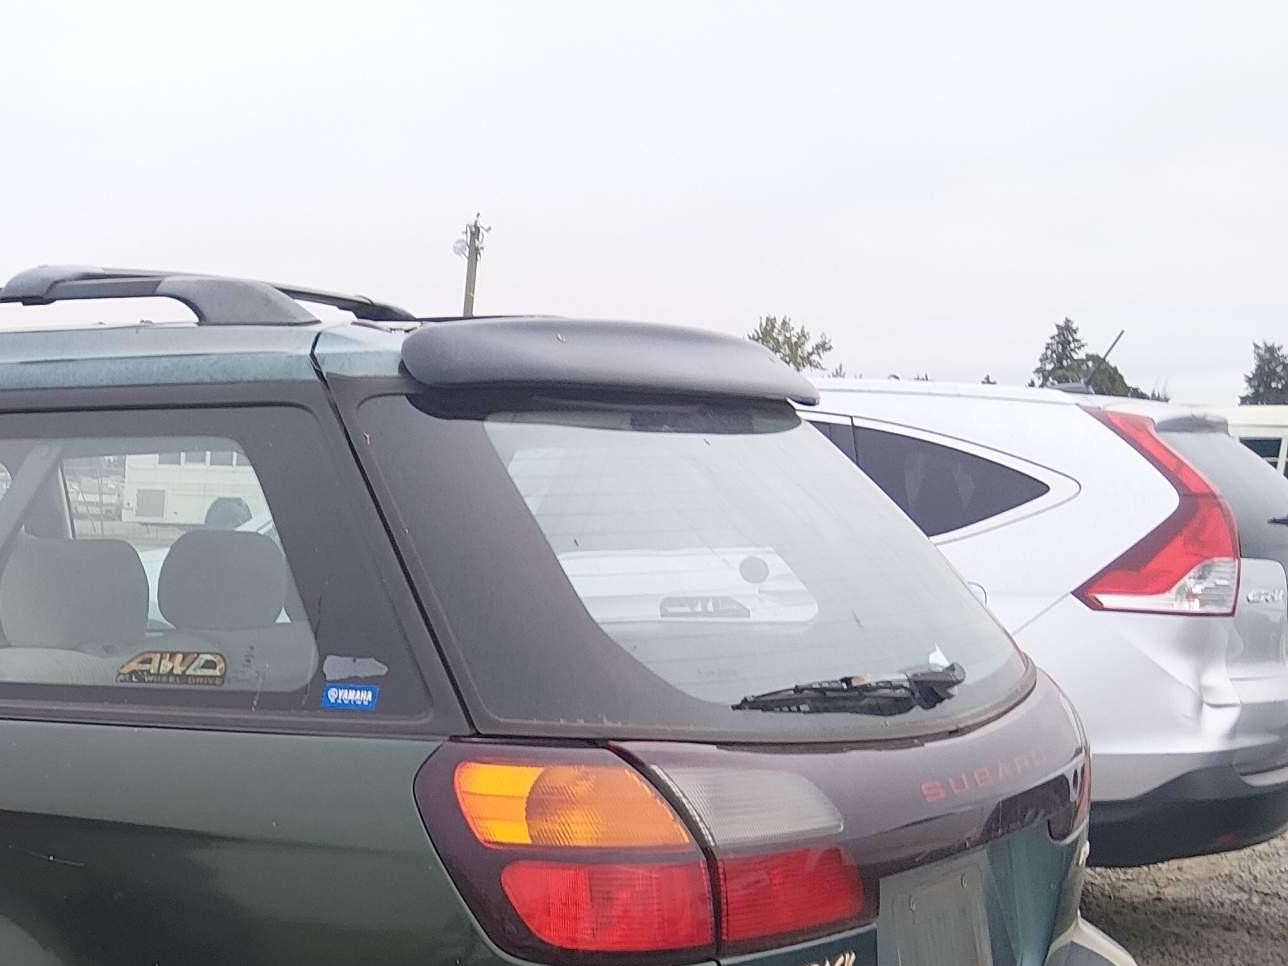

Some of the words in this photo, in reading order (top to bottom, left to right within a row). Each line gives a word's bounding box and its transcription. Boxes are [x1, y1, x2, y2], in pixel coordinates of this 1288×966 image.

[118, 652, 226, 676] AWD
[338, 687, 373, 703] YAMAHA
[920, 748, 1048, 804] SUBARU
